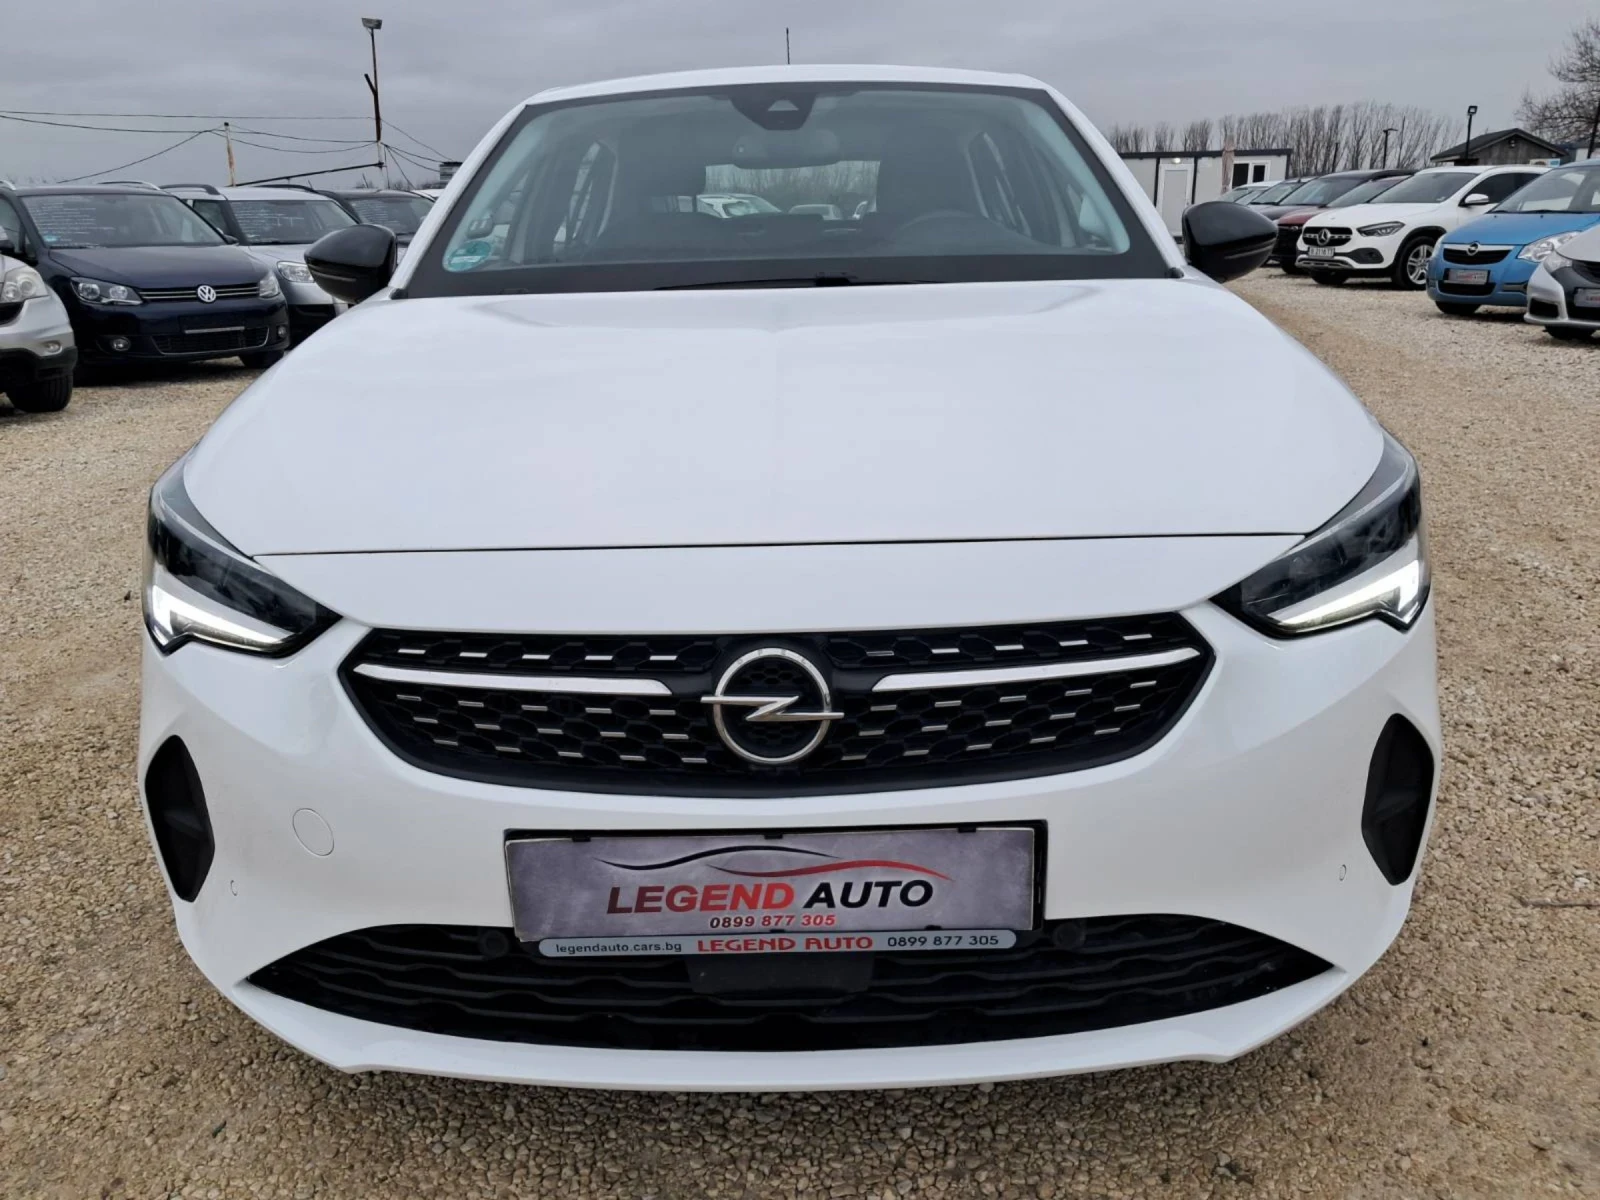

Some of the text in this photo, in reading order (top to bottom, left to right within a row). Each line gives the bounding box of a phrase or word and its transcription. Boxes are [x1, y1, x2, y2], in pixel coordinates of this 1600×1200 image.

[607, 880, 933, 914] LEGEND AUTO
[710, 915, 836, 929] 0899 877 305
[556, 942, 682, 954] legendauto.cars.bg
[697, 937, 873, 952] LEGEND AUTO
[887, 935, 999, 947] 0899 877 305
